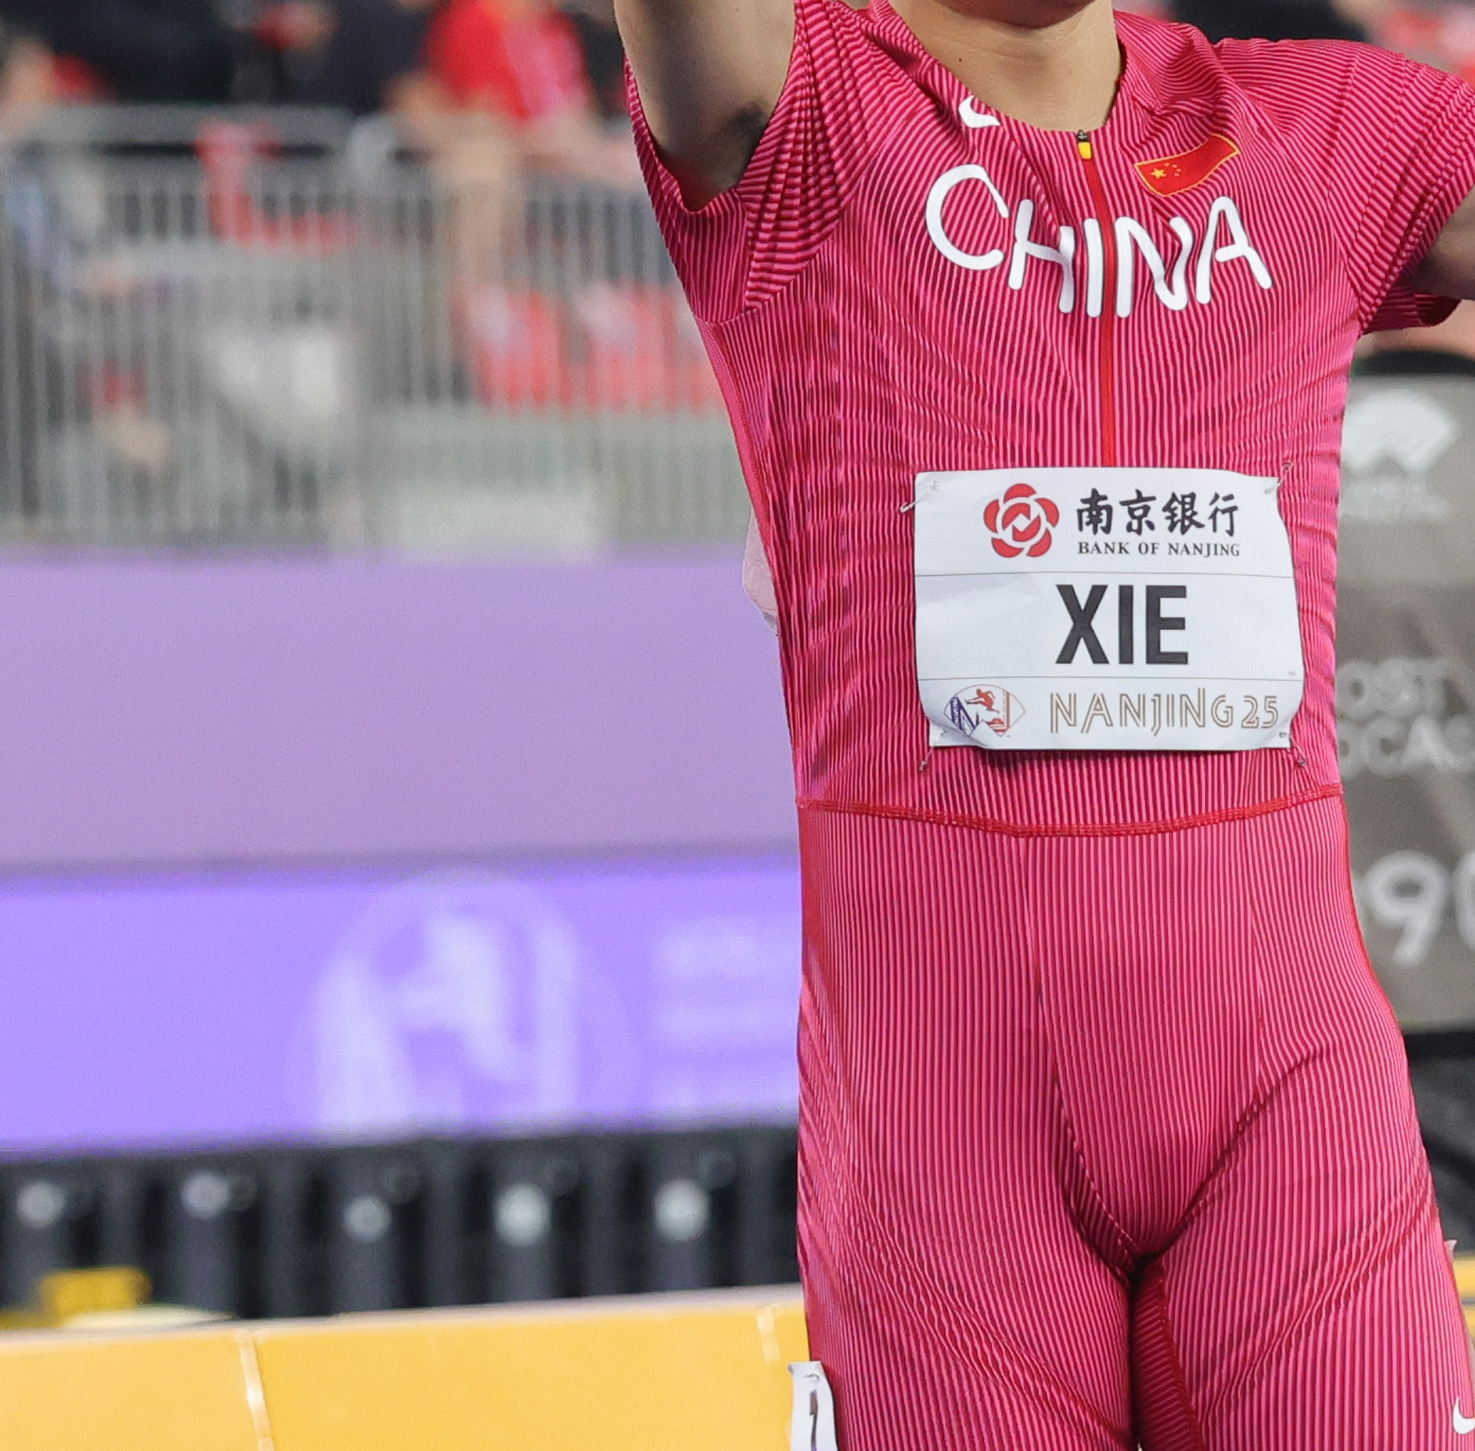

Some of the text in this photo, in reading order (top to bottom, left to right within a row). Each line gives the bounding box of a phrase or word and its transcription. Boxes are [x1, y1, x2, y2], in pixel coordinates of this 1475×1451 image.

[924, 163, 1273, 317] CHINA
[1076, 487, 1239, 537] 南京银行
[1078, 542, 1241, 558] BANK OF NANJING
[1055, 583, 1188, 665] XIE
